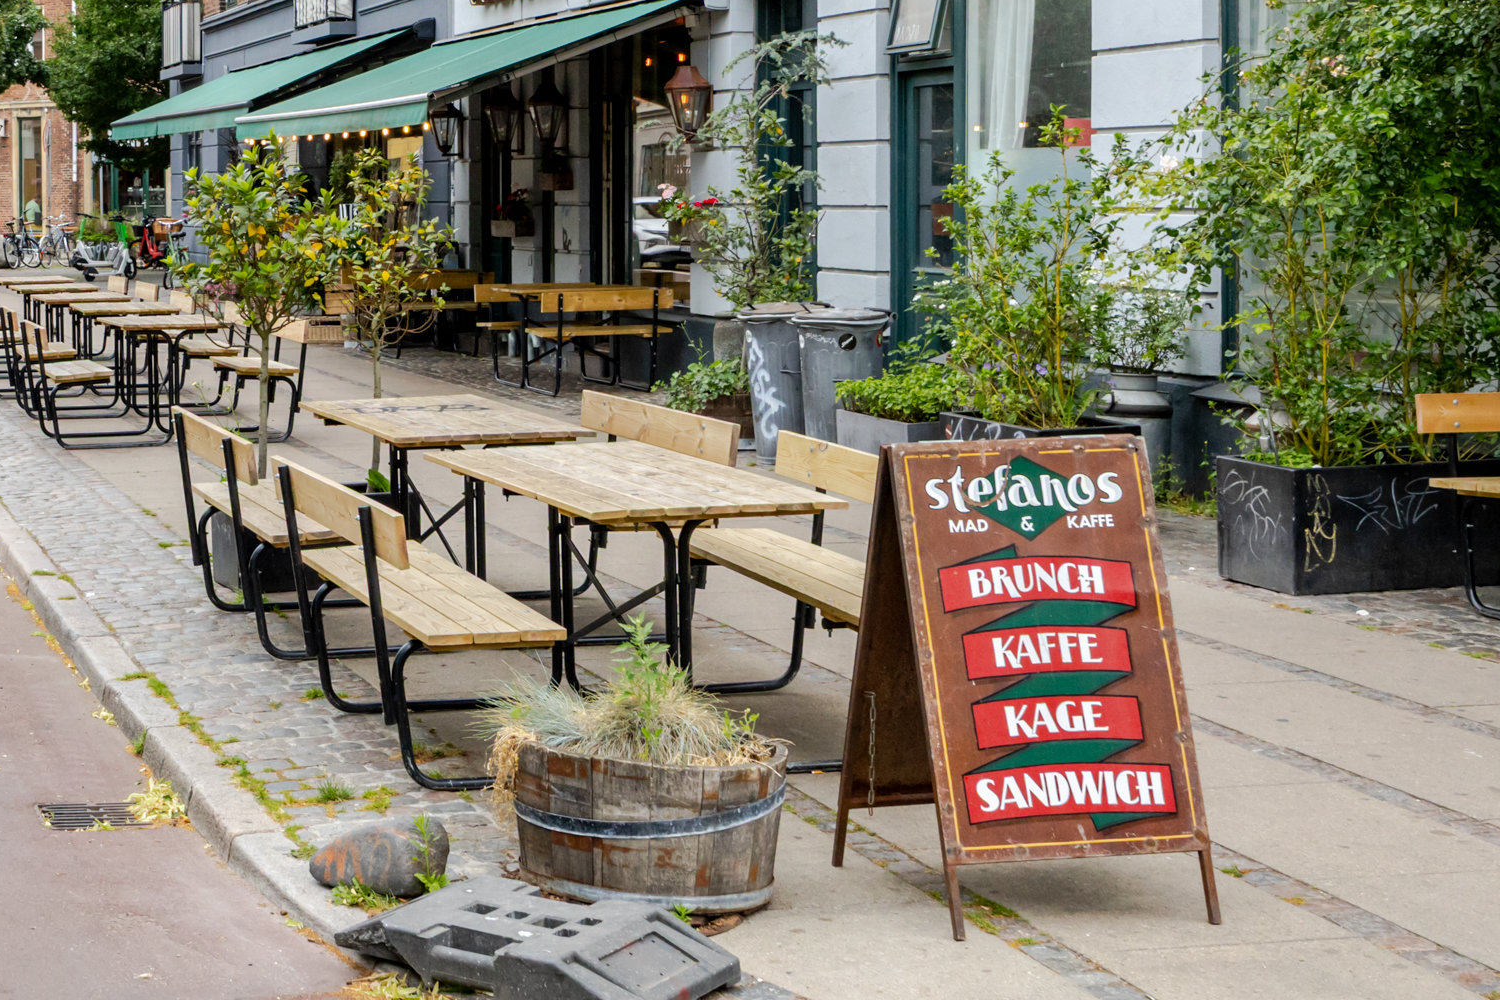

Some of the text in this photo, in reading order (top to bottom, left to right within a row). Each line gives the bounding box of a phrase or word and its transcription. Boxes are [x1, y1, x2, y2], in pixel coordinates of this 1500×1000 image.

[924, 464, 1123, 513] stefanos
[948, 514, 1115, 533] MAD & KAFFE
[967, 562, 1106, 598] BRUNCH
[991, 632, 1104, 669] KAFFE
[1004, 700, 1109, 739] KAGE
[975, 770, 1166, 813] SANDWICH
